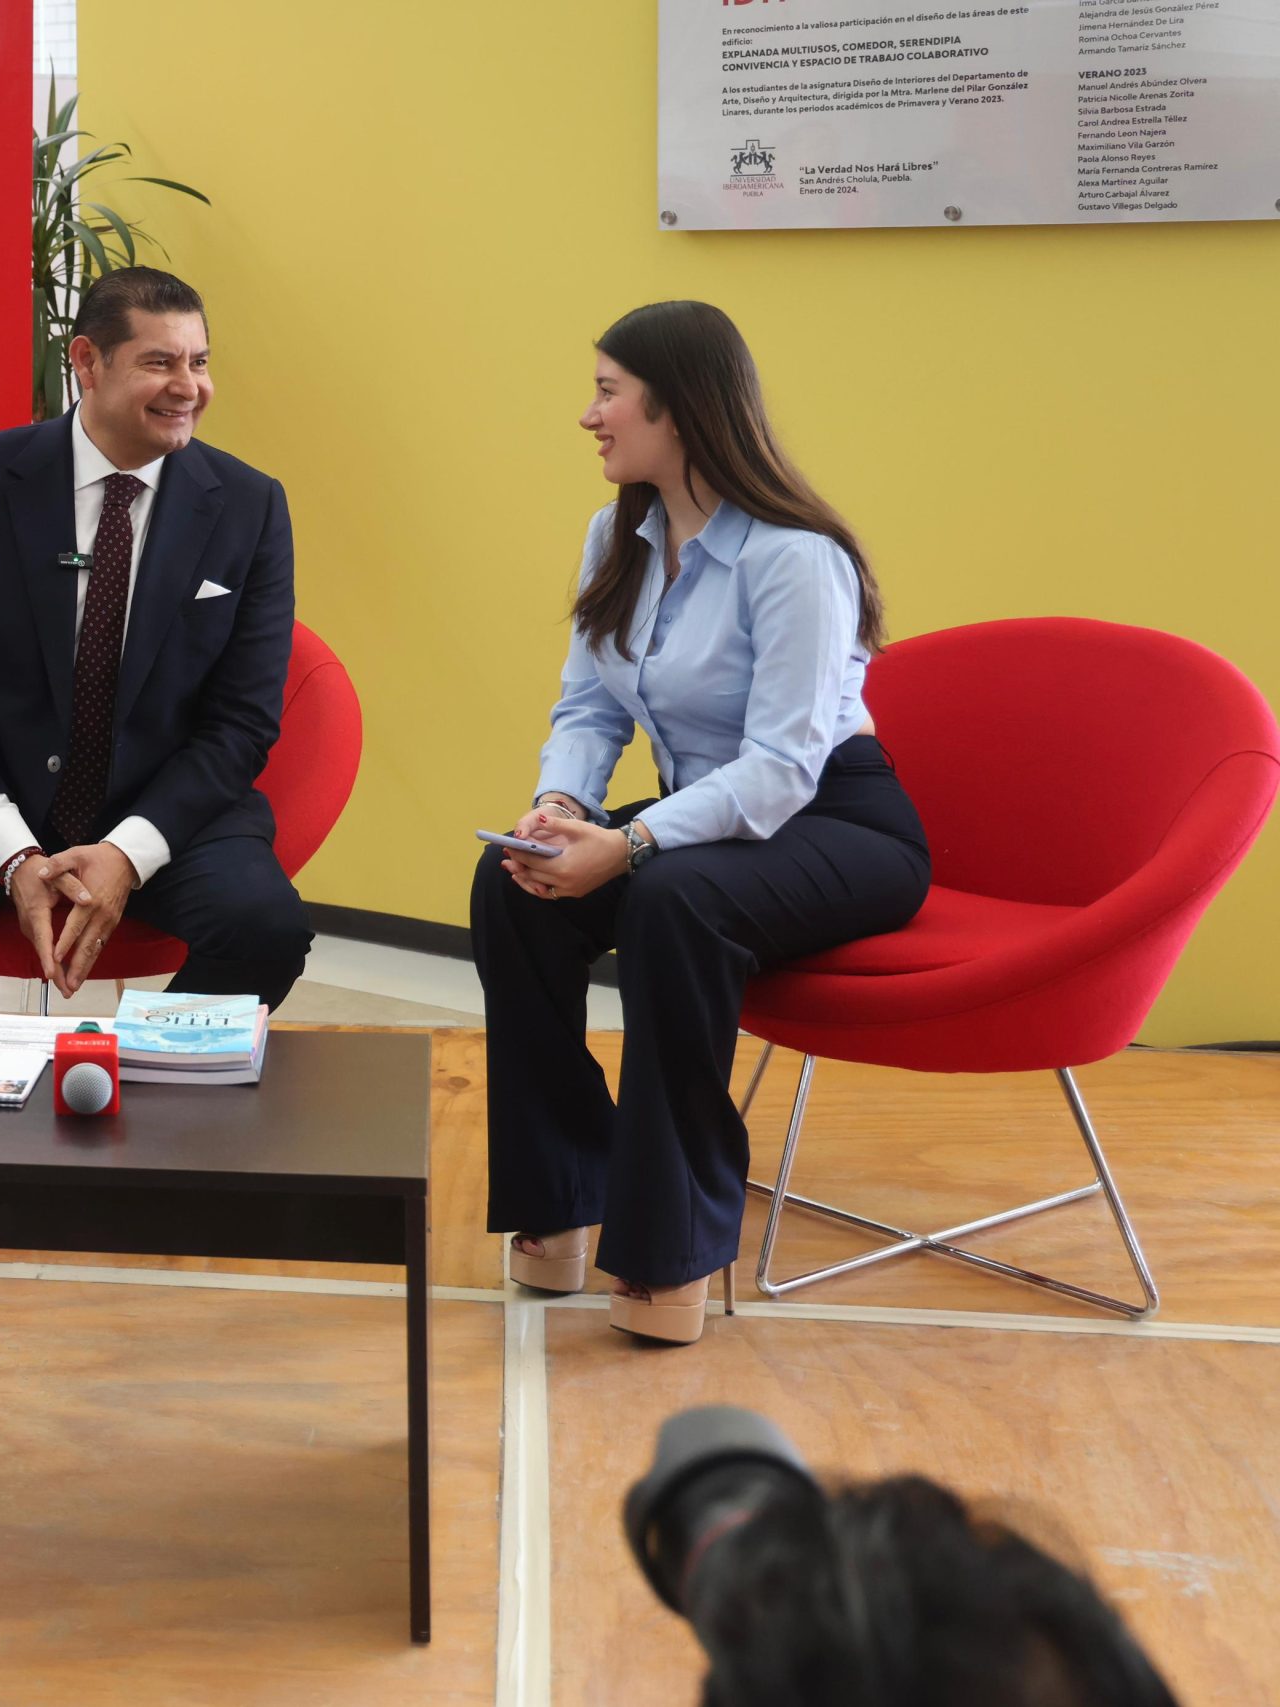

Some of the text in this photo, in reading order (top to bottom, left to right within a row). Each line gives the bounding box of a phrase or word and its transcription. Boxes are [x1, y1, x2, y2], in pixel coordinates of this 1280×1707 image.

[1079, 10, 1117, 19] Alejandra
[1131, 7, 1153, 15] Jesús
[722, 27, 732, 35] En
[733, 23, 794, 34] reconocimiento
[810, 20, 838, 29] valiosa
[839, 16, 893, 28] participación
[907, 14, 914, 22] el
[916, 12, 944, 21] diseño
[997, 8, 1008, 16] de
[1010, 6, 1029, 15] este
[1078, 23, 1107, 31] Jimena
[1108, 20, 1154, 29] Hernández
[722, 38, 753, 46] edificio:
[1079, 30, 1182, 43] Romina Ochoa Cervantes
[722, 36, 961, 59] EXPLANADA MULTIUSOS, COMEDOR, SERENDIPIA
[1078, 42, 1186, 55] Armando Tamariz Sánchez
[722, 48, 989, 71] CONVIVENCIA Y ESPACIO DE TRABAJO COLABORATIVO
[1078, 67, 1147, 79] VERANO 2023
[722, 86, 728, 94] A
[742, 83, 787, 93] estudiantes
[809, 80, 851, 90] asignatura
[853, 78, 881, 87] Diseño
[883, 77, 894, 85] de
[895, 76, 935, 84] Interiores
[937, 74, 951, 82] del
[952, 71, 1015, 82] Departamento
[1017, 70, 1028, 78] de
[1078, 83, 1108, 91] Manuel
[1109, 82, 1138, 90] Andrés
[1180, 77, 1207, 85] Olvera
[722, 97, 741, 106] Arte,
[743, 96, 769, 104] Diseño
[778, 93, 831, 103] Arquitectura,
[832, 91, 864, 100] dirigida
[865, 91, 879, 99] por
[915, 87, 949, 95] Marlene
[967, 85, 986, 93] Pilar
[988, 83, 1028, 92] González
[1078, 95, 1108, 103] Patricia
[1139, 92, 1168, 100] Arenas
[1170, 90, 1194, 98] Zorita
[722, 109, 752, 117] Linares,
[753, 106, 784, 115] durante
[799, 104, 834, 114] periodos
[836, 102, 883, 111] académicos
[898, 100, 940, 108] Primavera
[941, 99, 947, 107] y
[981, 95, 1004, 104] 2023.
[1078, 104, 1166, 115] Silvia Barbosa Estrada
[1100, 118, 1130, 126] Andrea
[1132, 116, 1162, 125] Estrella
[1078, 131, 1116, 139] Fernando
[1077, 143, 1126, 151] Maximiliano
[1145, 140, 1174, 148] Garzón
[1077, 155, 1099, 163] Paola
[1131, 154, 1156, 162] Reyes
[818, 164, 853, 174] Verdad
[855, 165, 874, 173] Nos
[877, 163, 900, 172] Hará
[1077, 167, 1100, 175] María
[1101, 166, 1139, 174] Fernanda
[1141, 165, 1182, 173] Contreras
[799, 174, 912, 184] San Andrés Cholula, Puebla.
[1138, 177, 1168, 186] Aguilar
[722, 182, 784, 190] IBEROAMERICANA
[799, 186, 859, 195] Enero de 2024.
[1105, 190, 1138, 199] Carbajal
[1139, 188, 1170, 197] Álvarez
[1077, 202, 1178, 211] Gustavo Villegas Delgado
[145, 1014, 228, 1025] LITIO
